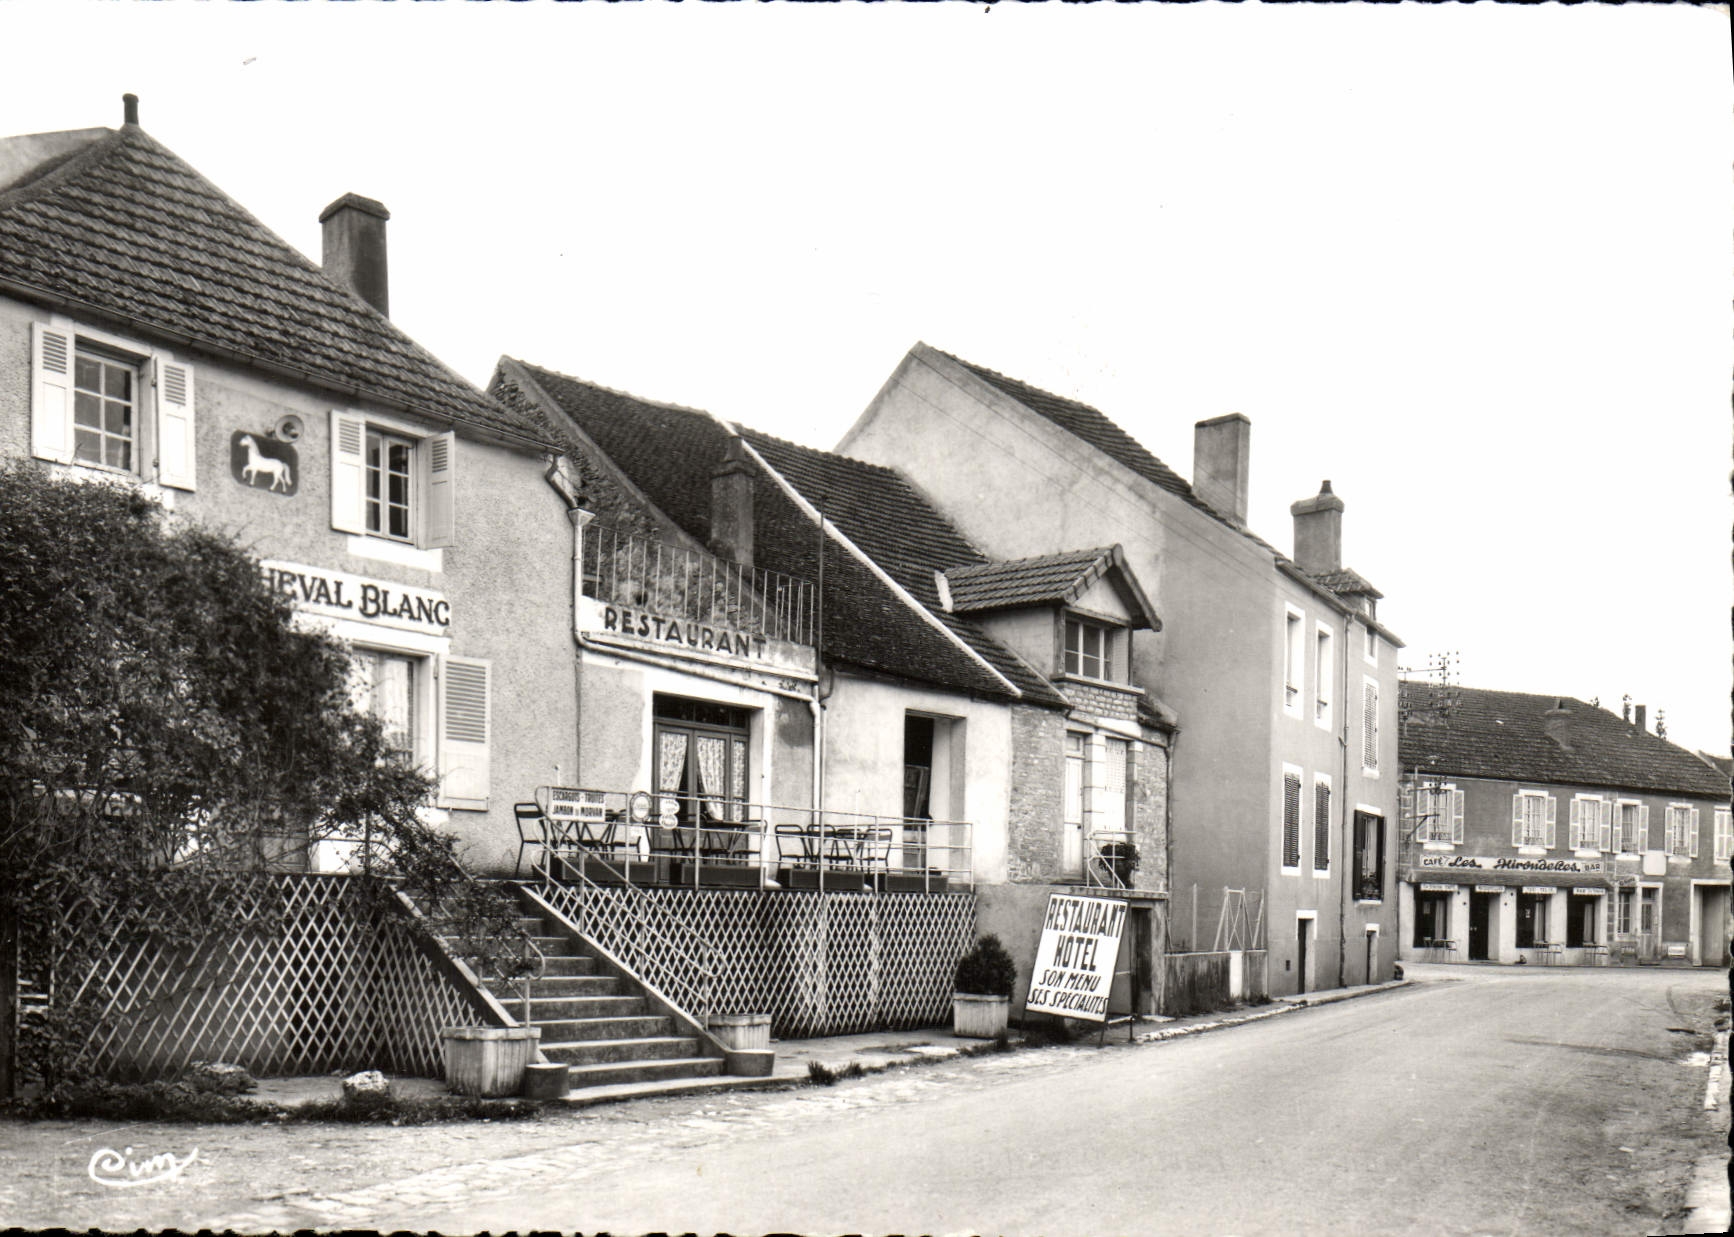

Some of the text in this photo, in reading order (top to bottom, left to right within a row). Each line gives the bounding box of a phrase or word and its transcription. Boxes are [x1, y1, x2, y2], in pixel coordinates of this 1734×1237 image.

[258, 567, 450, 627] HEVAL BLANC
[604, 606, 767, 659] RESTAURANT
[1045, 898, 1127, 938] RESTAURANT
[1039, 969, 1101, 992] SON MENU
[1027, 988, 1110, 1014] SES SPECIALITES
